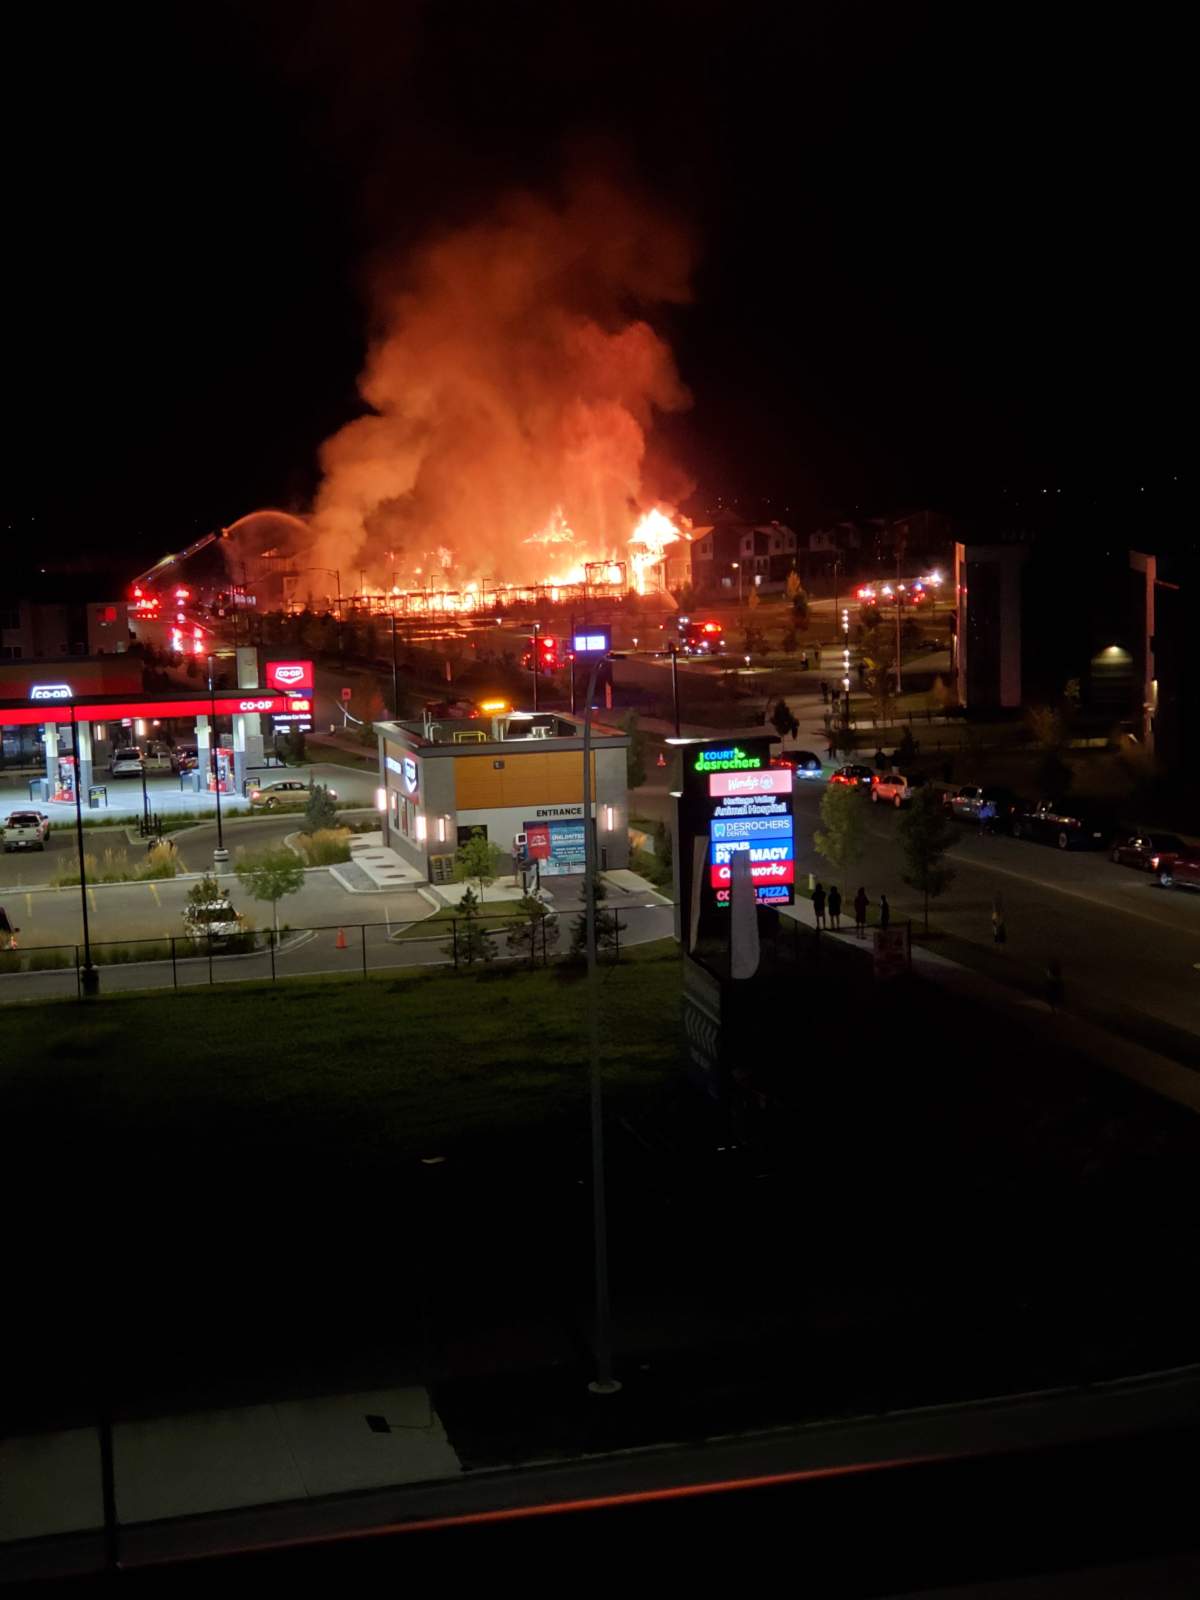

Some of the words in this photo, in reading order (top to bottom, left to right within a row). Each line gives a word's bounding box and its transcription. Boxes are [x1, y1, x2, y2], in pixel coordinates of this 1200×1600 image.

[240, 701, 272, 711] CO-OP
[704, 750, 735, 760] COURT
[695, 750, 760, 771] desrochers
[537, 808, 582, 816] ENTRANCE
[714, 805, 747, 816] Animal
[748, 802, 786, 815] Hospital
[726, 820, 790, 830] DESROCHERS
[716, 848, 788, 863] PHMACY
[759, 886, 788, 897] PIZZA
